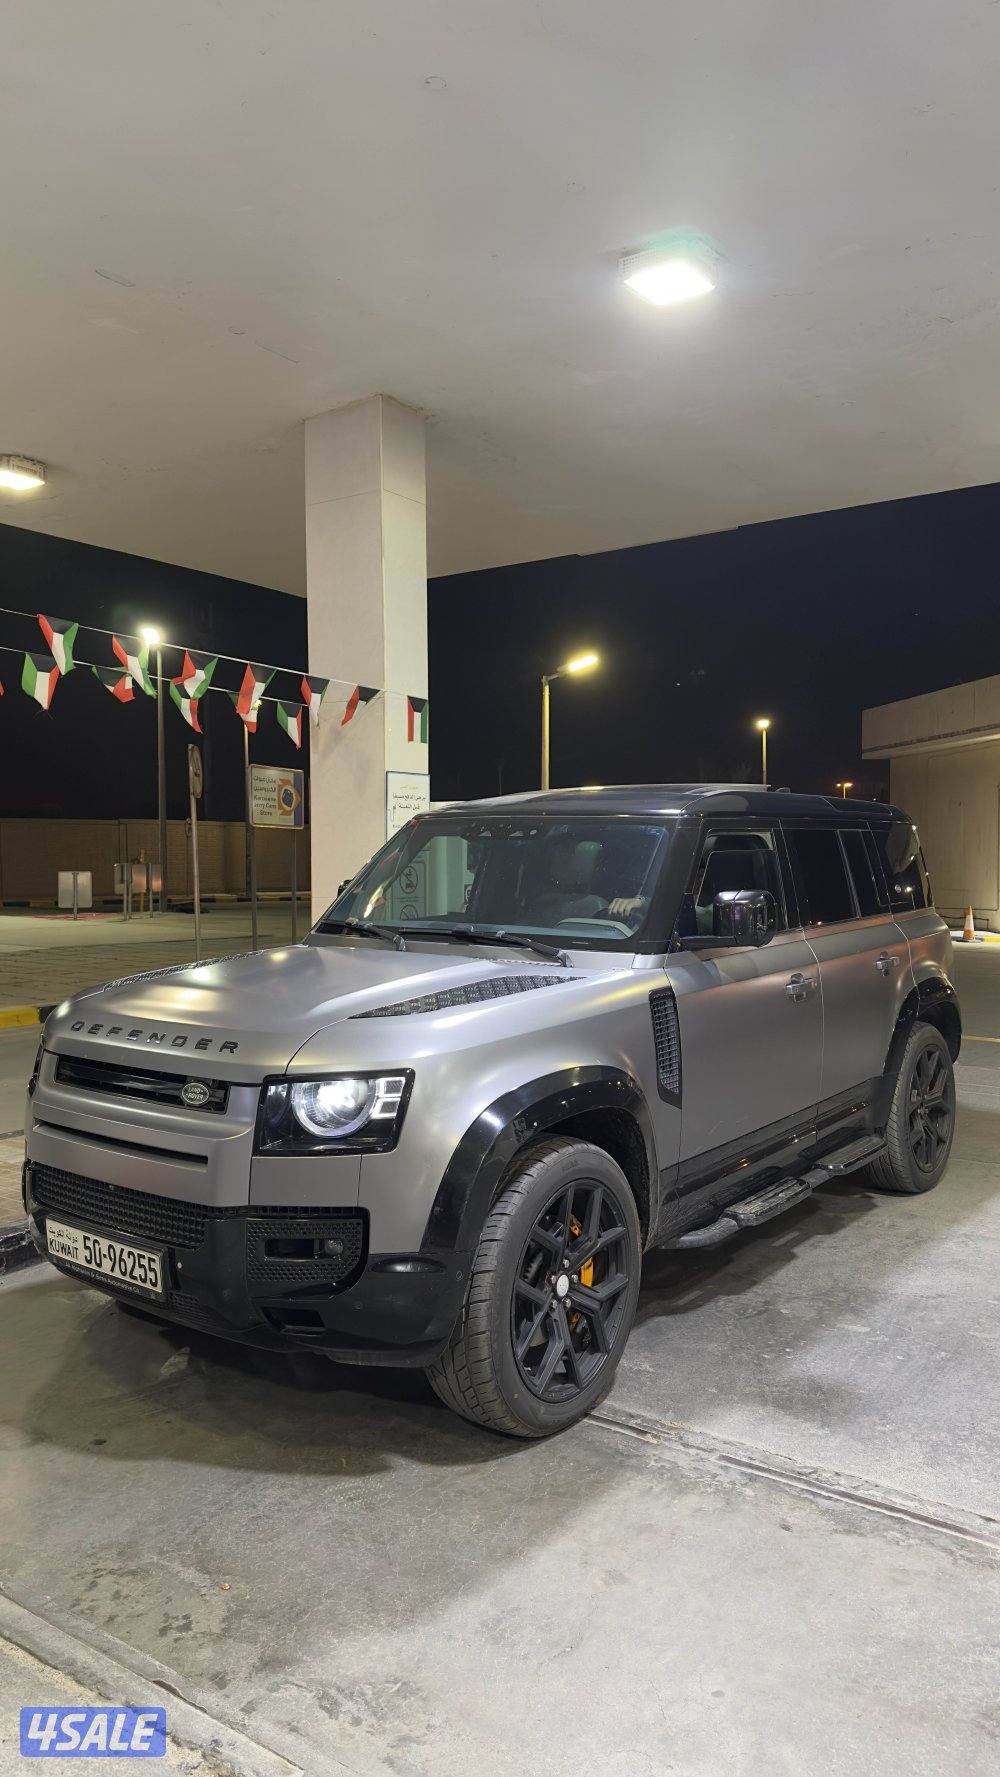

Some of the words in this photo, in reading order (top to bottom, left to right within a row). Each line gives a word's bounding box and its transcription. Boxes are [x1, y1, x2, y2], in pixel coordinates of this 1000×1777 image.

[71, 1021, 240, 1053] DEFENDER
[49, 1238, 79, 1260] KUWAIT
[83, 1235, 158, 1288] 50-96255
